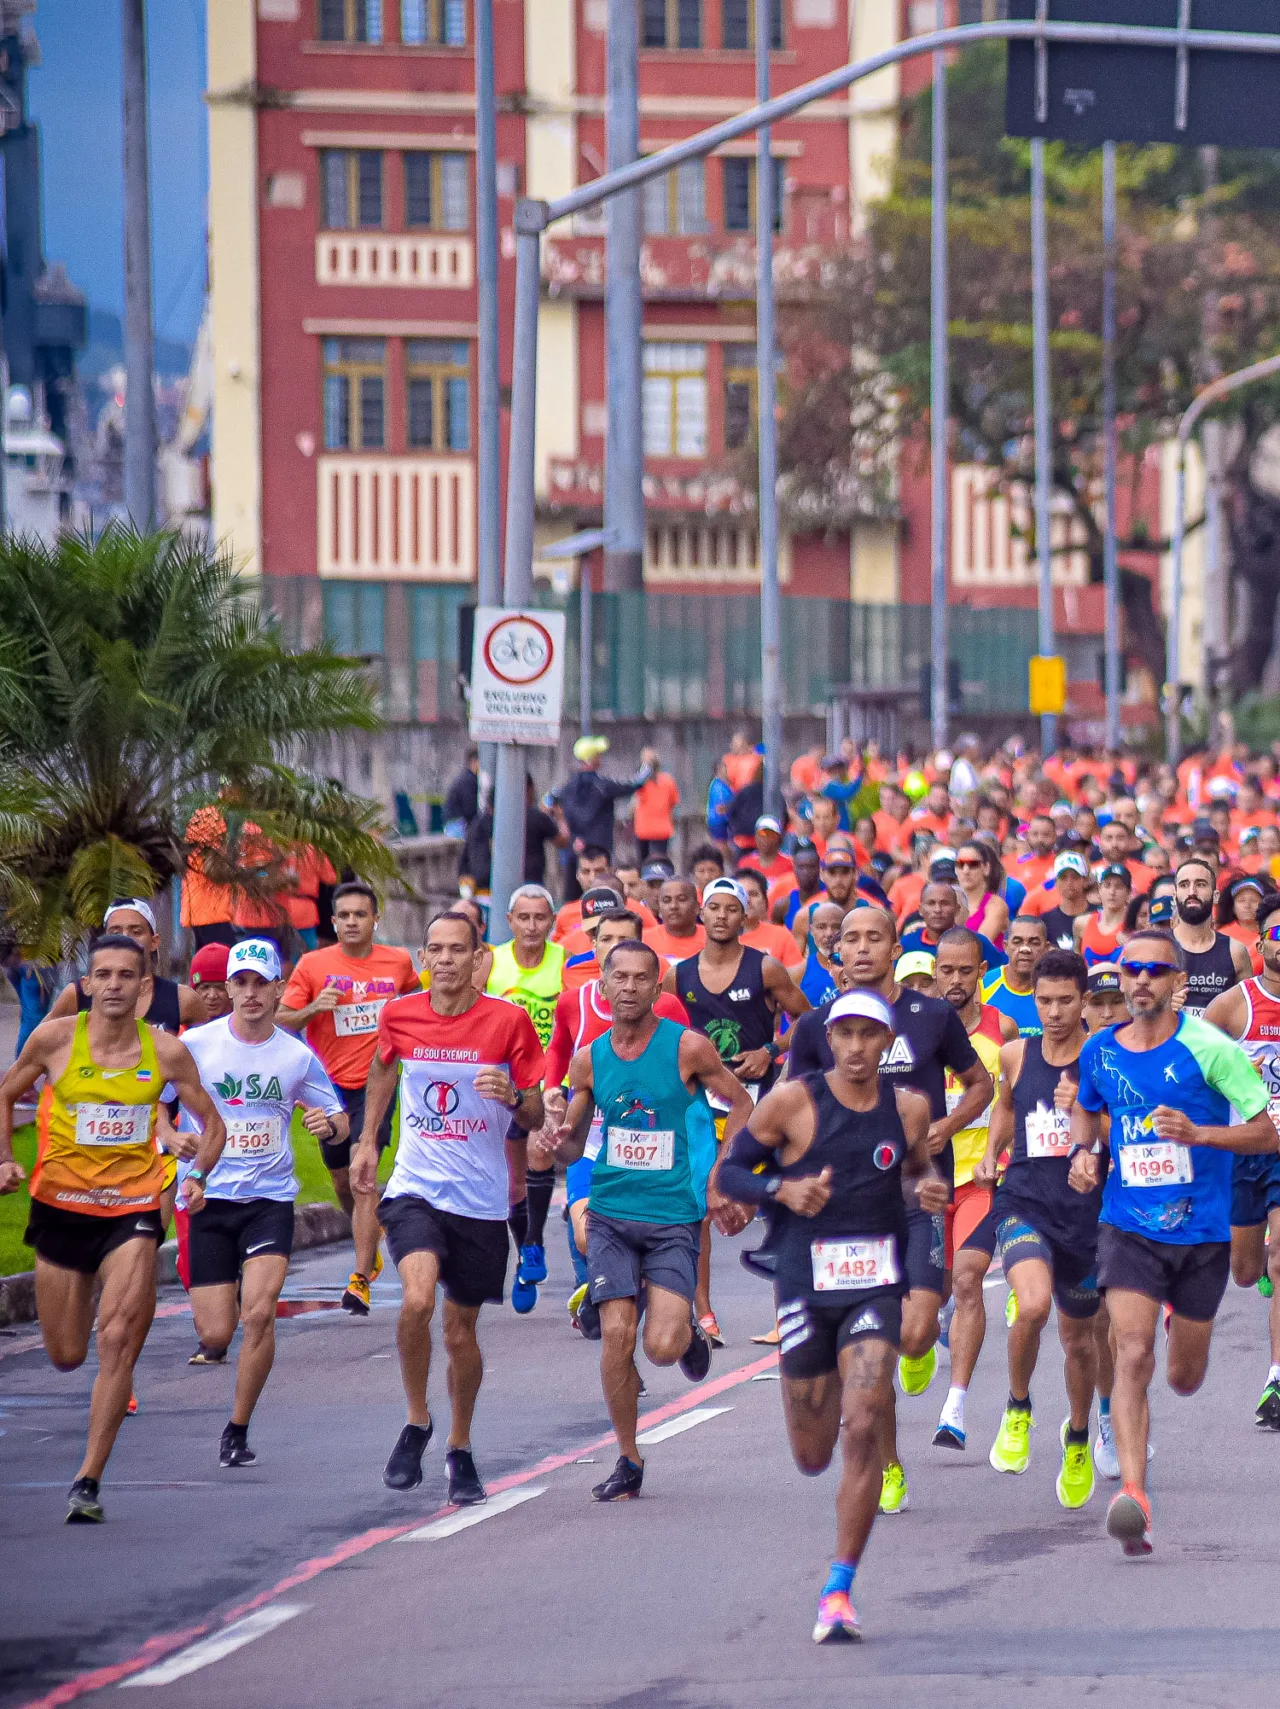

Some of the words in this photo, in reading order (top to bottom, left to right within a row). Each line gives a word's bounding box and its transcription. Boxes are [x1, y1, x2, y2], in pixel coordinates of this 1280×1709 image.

[248, 944, 268, 960] SA
[355, 1005, 365, 1013] IX
[1192, 1008, 1202, 1017] IX
[343, 1014, 377, 1027] 1791
[1260, 1025, 1269, 1035] EU
[413, 1048, 422, 1058] EU
[424, 1048, 439, 1059] SOU
[441, 1050, 478, 1061] EXEMPLO
[877, 1064, 913, 1074] mbiental
[245, 1074, 283, 1101] SA
[108, 1108, 120, 1118] IX
[86, 1120, 135, 1136] 1683
[246, 1122, 257, 1132] IX
[406, 1112, 488, 1134] OXIDATIVA
[1054, 1118, 1065, 1128] IX
[226, 1133, 270, 1148] 1503
[630, 1133, 641, 1143] IX
[1036, 1131, 1071, 1147] 103
[615, 1144, 658, 1160] 1607
[1143, 1148, 1154, 1158] IX
[1130, 1159, 1174, 1177] 1696
[845, 1245, 858, 1257] IX
[824, 1259, 877, 1278] 1482
[850, 1323, 880, 1335] adidas
